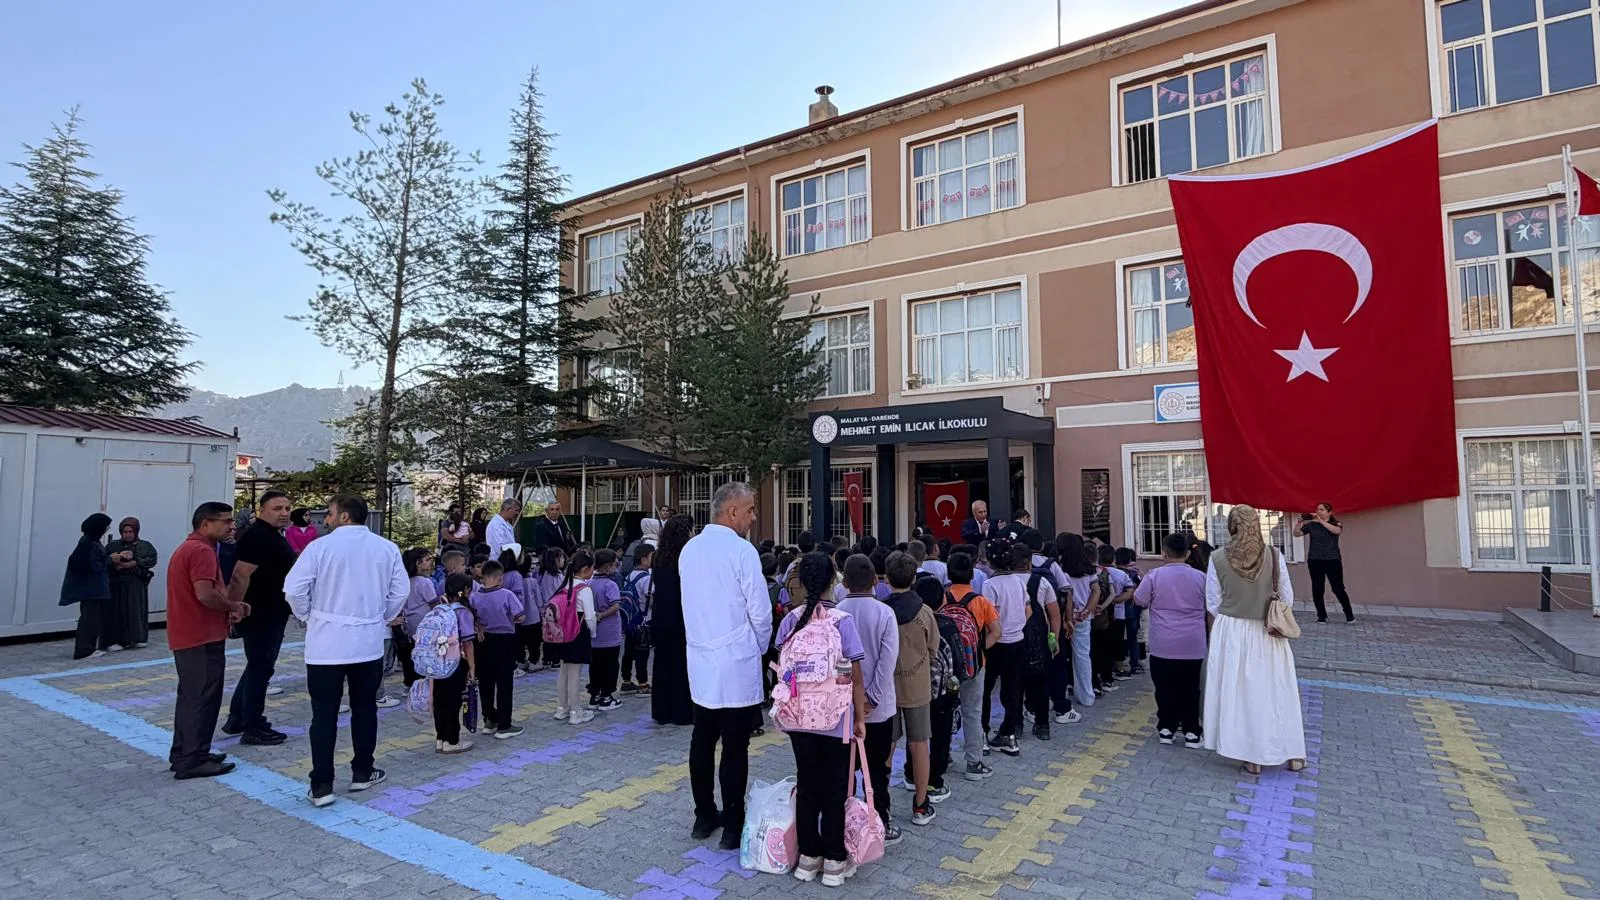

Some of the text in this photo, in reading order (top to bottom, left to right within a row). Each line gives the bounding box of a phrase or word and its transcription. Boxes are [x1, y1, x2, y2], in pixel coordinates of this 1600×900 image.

[840, 416, 868, 424] MALATYA
[840, 418, 988, 436] MEHMET EMİN ILICAK İLKOKULU
